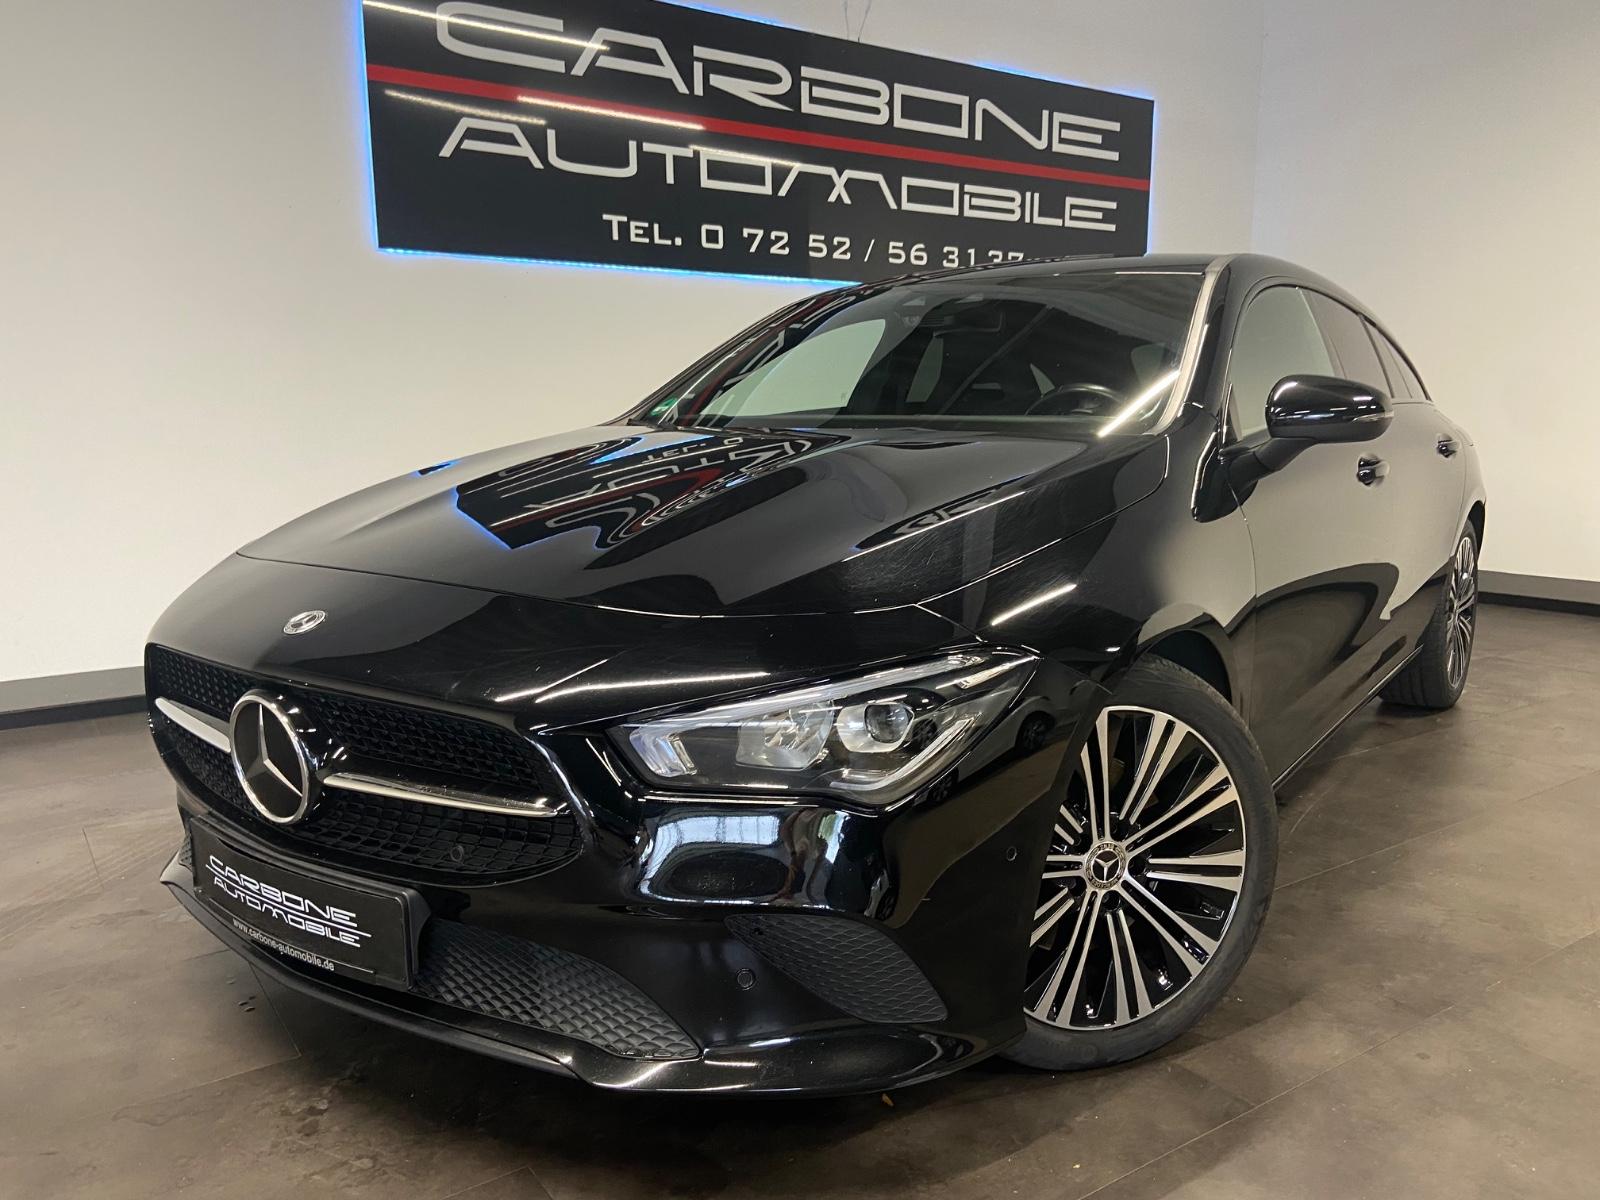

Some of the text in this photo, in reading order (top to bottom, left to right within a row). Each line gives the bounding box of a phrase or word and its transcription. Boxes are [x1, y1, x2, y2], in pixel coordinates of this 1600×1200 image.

[436, 1, 1121, 161] CARBONE
[438, 117, 1117, 231] AUTOMOBILE
[701, 224, 724, 250] 0
[742, 227, 790, 255] 72
[808, 234, 852, 261] 52
[888, 241, 928, 266] 56
[209, 855, 358, 928] CARBONE
[213, 876, 361, 948] AUTOMOBILE
[232, 917, 335, 972] www.carbone-automobile.de
